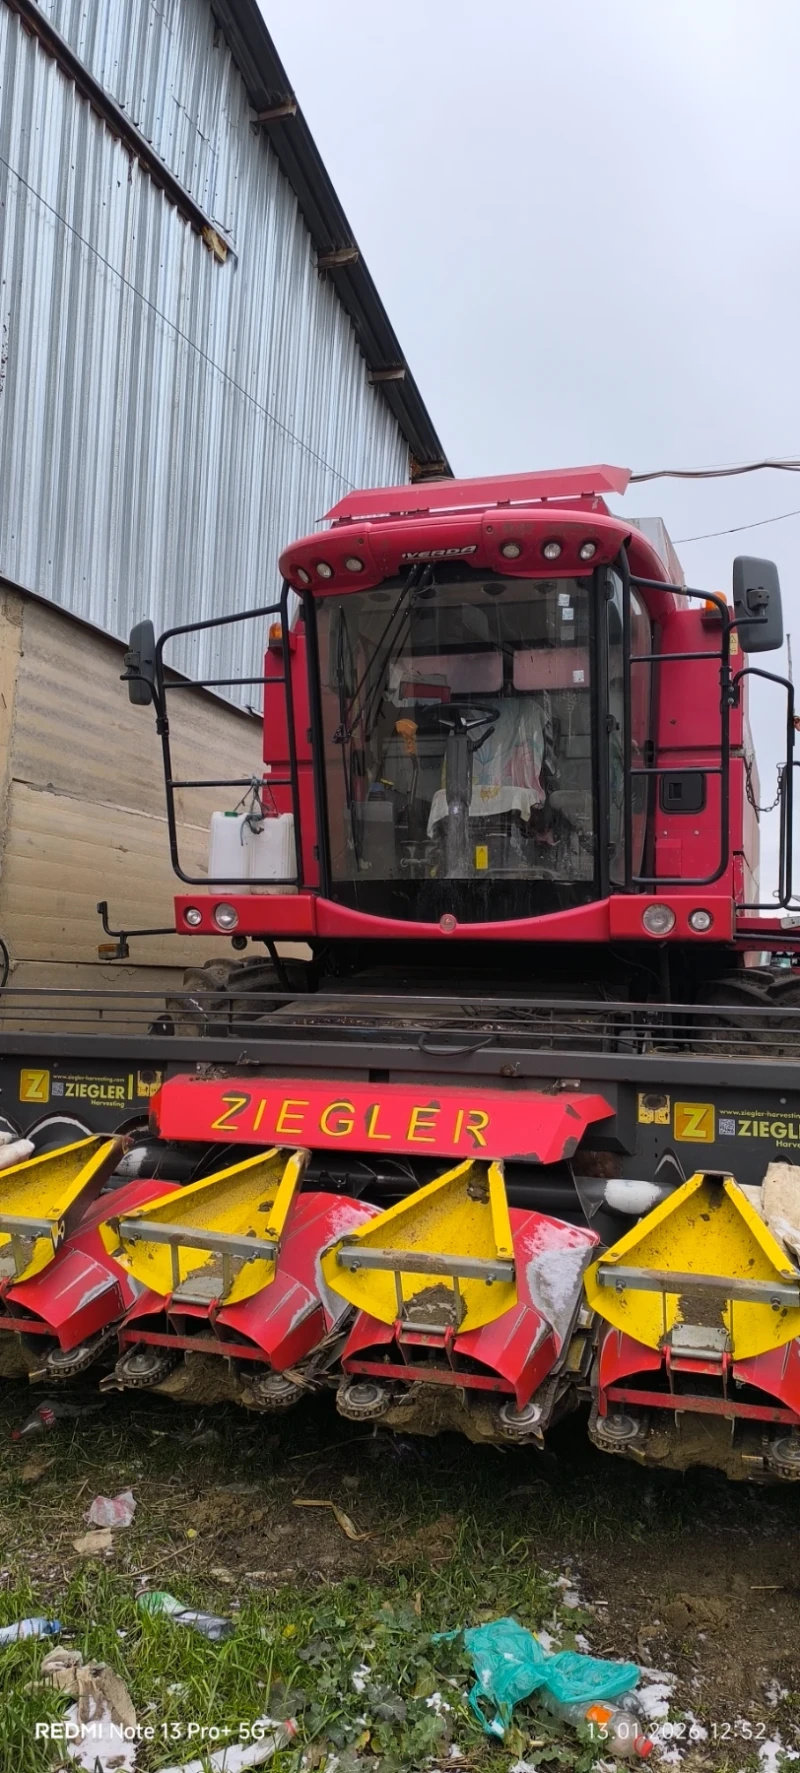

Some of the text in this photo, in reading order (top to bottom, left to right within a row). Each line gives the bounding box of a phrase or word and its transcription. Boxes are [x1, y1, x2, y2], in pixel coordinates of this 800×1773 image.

[25, 1074, 45, 1098] Z
[53, 1074, 125, 1083] www.ziegler-harvesting.com
[65, 1083, 125, 1099] ZIEGLER
[91, 1100, 125, 1108] Harvesting
[211, 1097, 489, 1146] ZIEGLER
[681, 1107, 707, 1138] Z
[738, 1120, 800, 1140] ZIEGL
